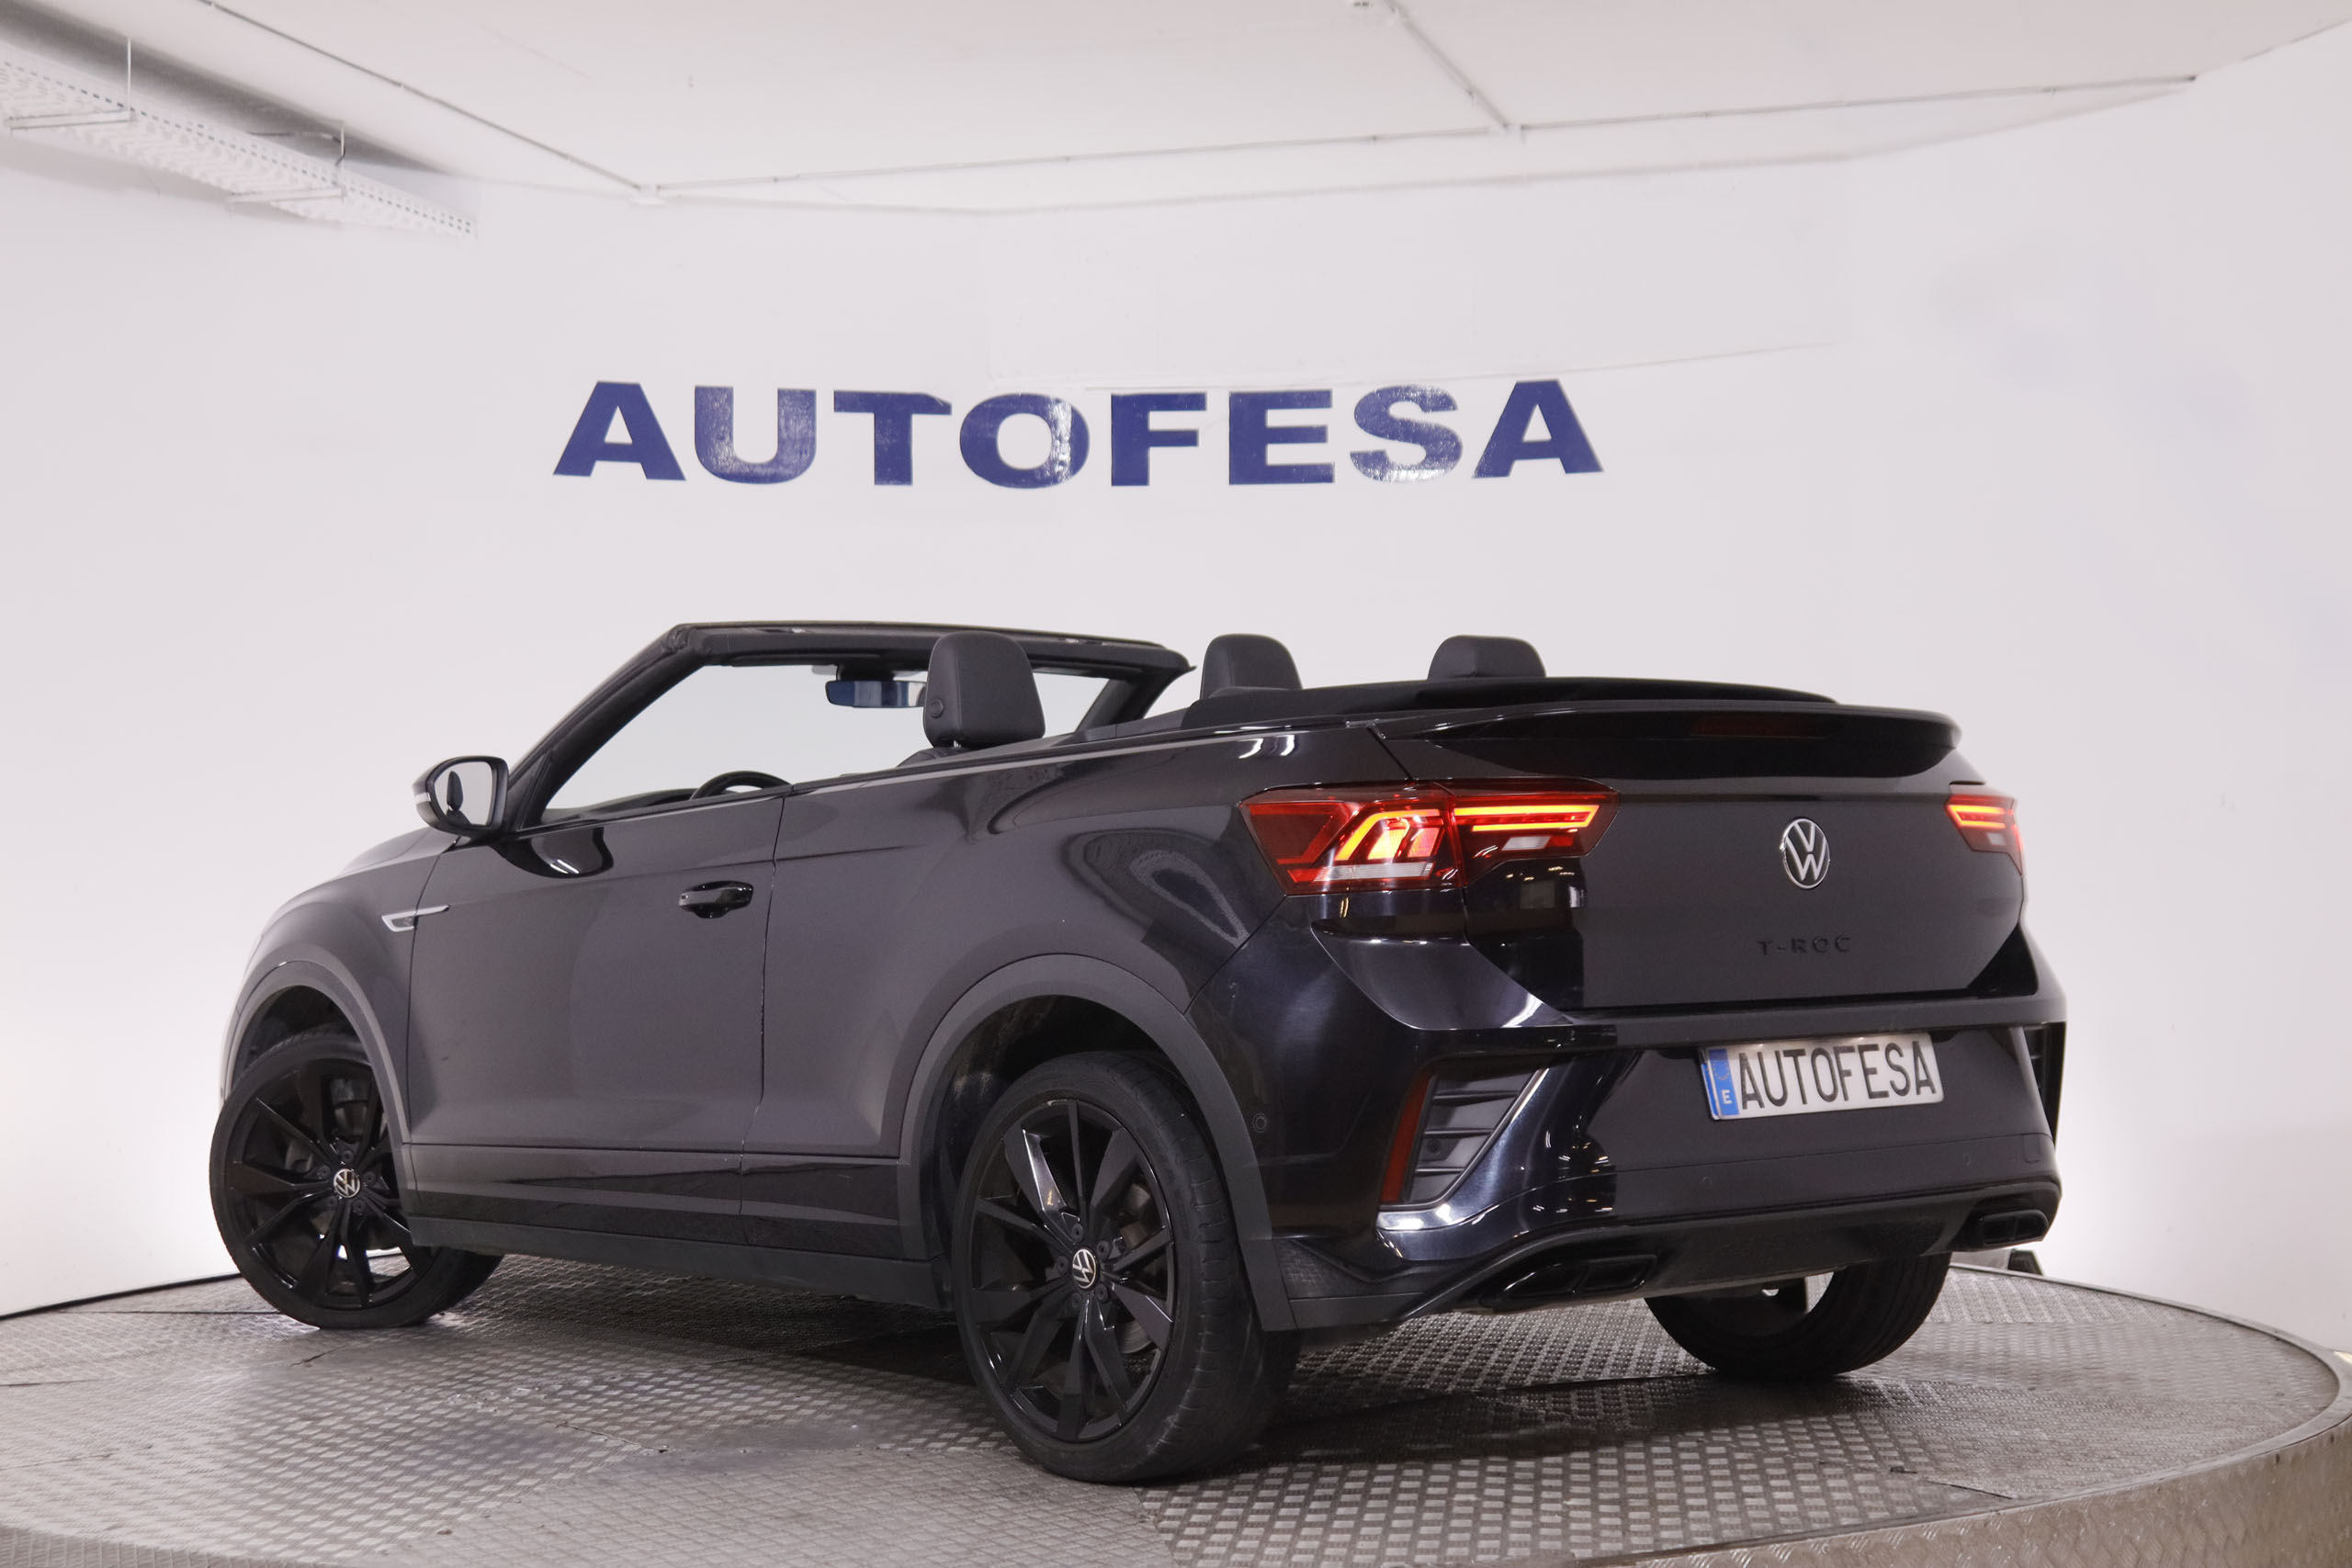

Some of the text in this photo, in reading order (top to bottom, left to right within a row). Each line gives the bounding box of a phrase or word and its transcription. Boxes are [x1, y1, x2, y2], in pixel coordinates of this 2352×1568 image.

[552, 379, 1605, 489] AUTOFESA
[1757, 934, 1851, 956] T-ROC
[1722, 1089, 1733, 1104] E
[1739, 1041, 1937, 1111] AUTOFESA
